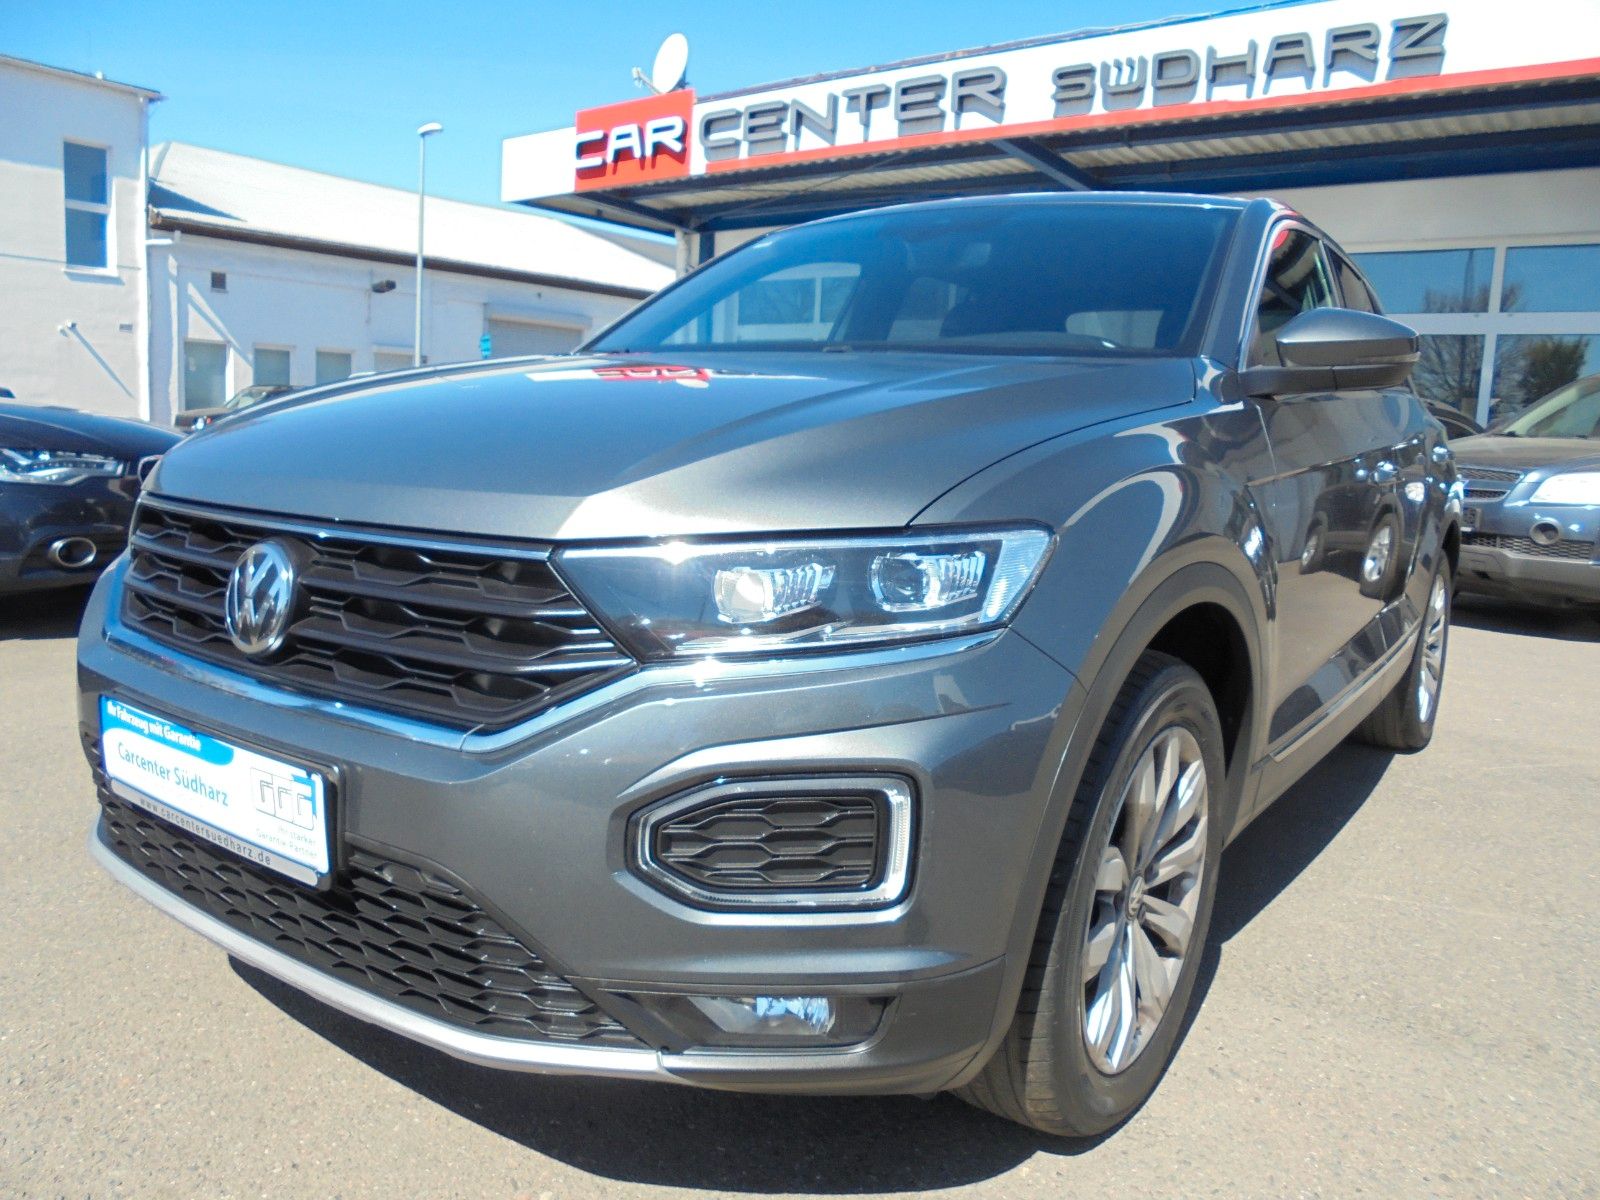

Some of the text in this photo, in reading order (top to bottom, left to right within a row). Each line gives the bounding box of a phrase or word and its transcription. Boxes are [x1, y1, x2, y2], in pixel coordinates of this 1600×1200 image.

[574, 115, 685, 169] CAR
[699, 66, 1006, 151] CENTER
[118, 741, 229, 807] Carcenter Südharz
[140, 798, 272, 866] www.carcentersuedharz.de
